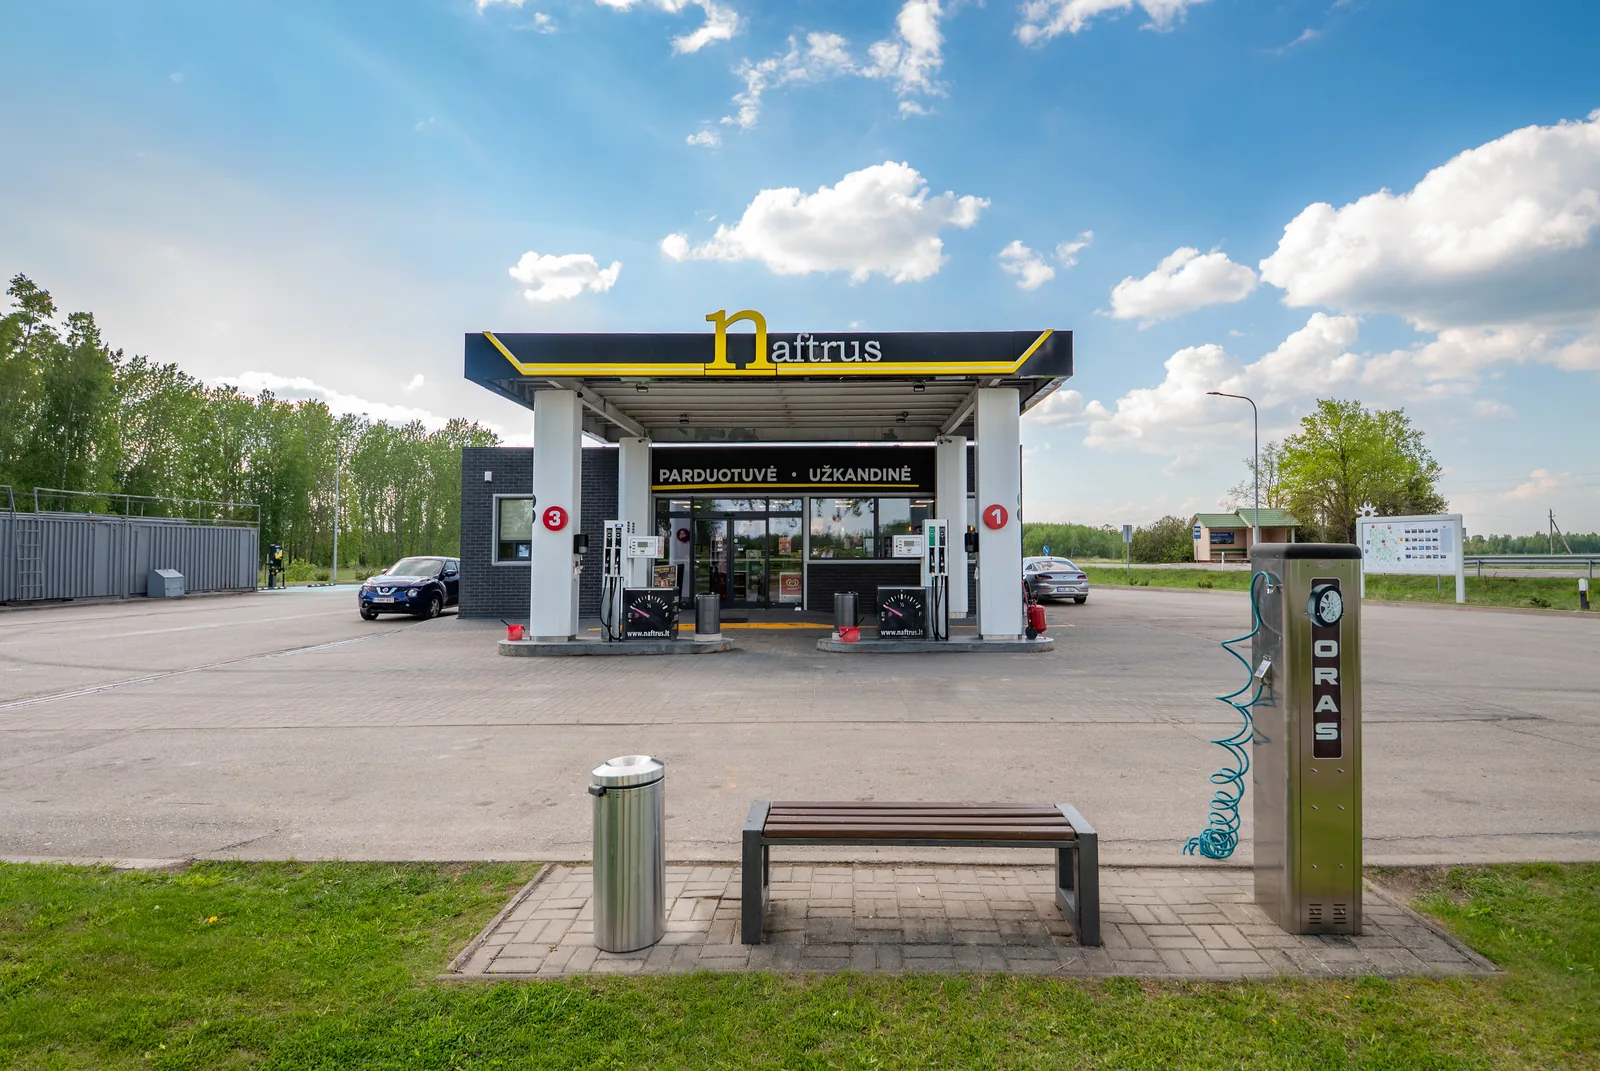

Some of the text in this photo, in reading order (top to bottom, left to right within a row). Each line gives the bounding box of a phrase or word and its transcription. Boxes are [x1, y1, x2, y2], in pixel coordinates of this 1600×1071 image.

[706, 310, 882, 369] naftrus
[659, 465, 911, 482] PARDUOTUVĖ UŽKANDINĖ
[548, 510, 560, 526] 3
[991, 508, 1001, 525] 1
[1314, 640, 1339, 740] ORAS
